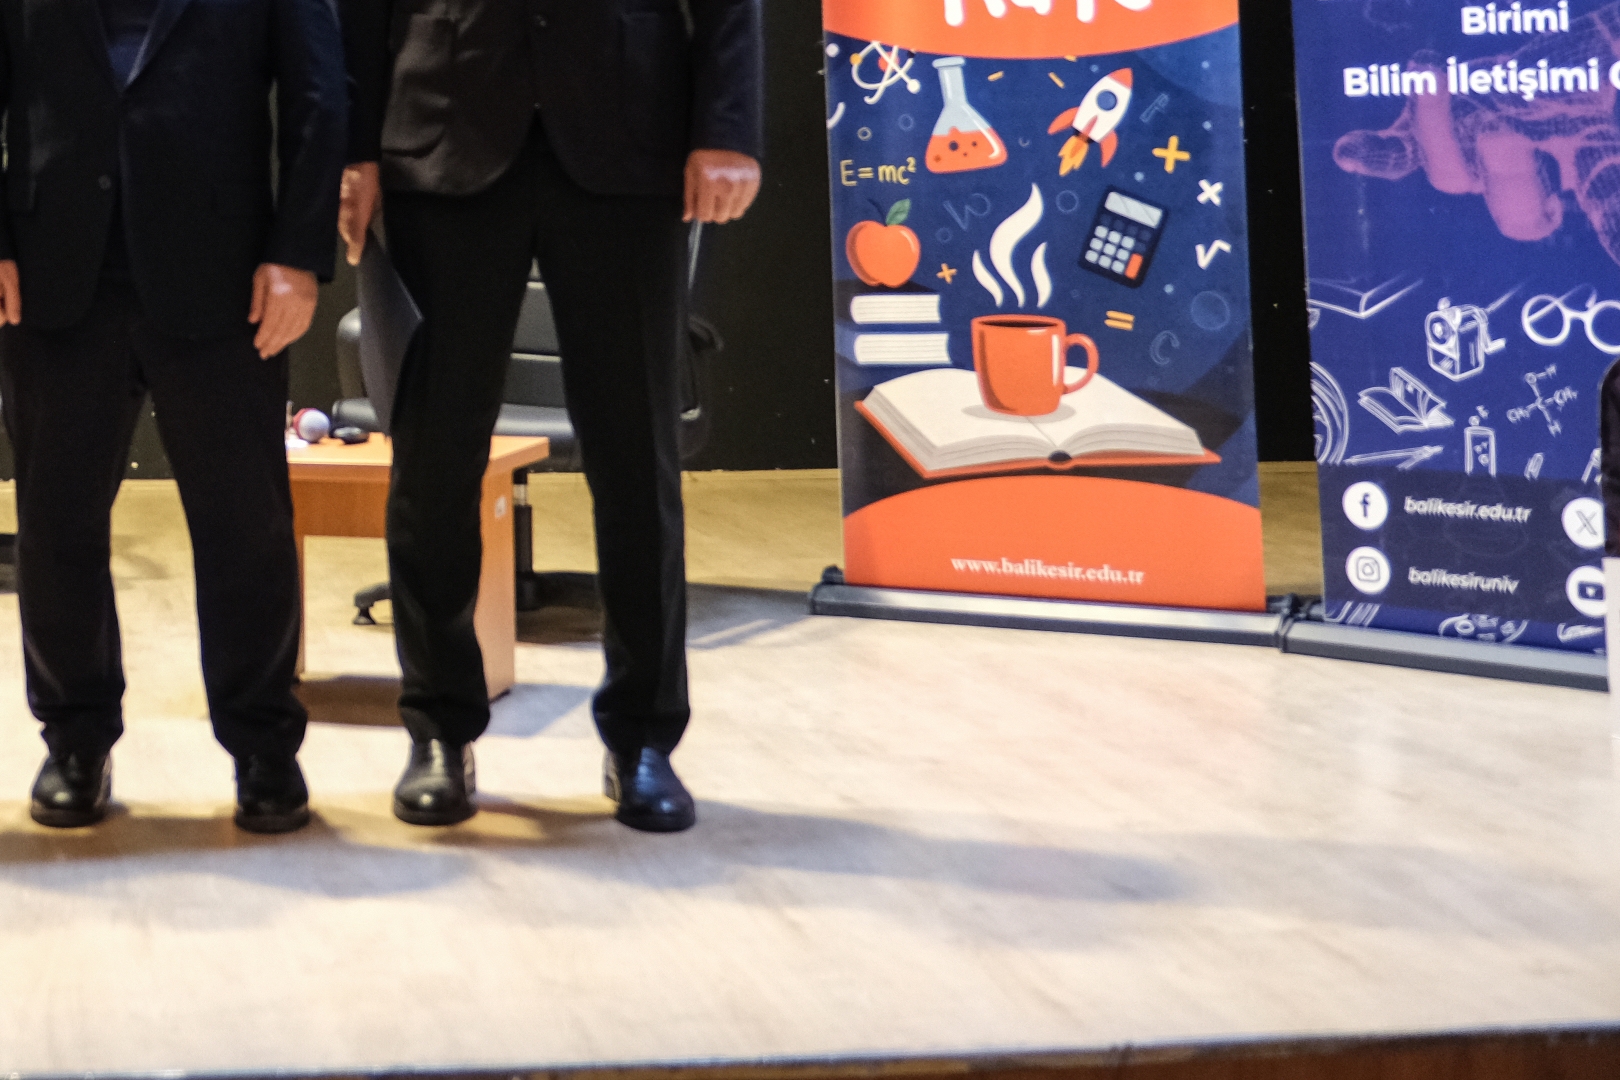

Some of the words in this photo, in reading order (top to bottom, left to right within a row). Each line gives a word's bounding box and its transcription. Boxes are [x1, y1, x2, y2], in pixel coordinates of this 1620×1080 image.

[1461, 0, 1570, 35] Birimi
[1343, 63, 1437, 97] Bilim
[1446, 56, 1599, 101] İletişimi
[1404, 496, 1533, 523] balikesir.edu.tr
[950, 557, 1145, 585] www.balikesir.edu.tr
[1408, 566, 1520, 595] balikesiruniv
